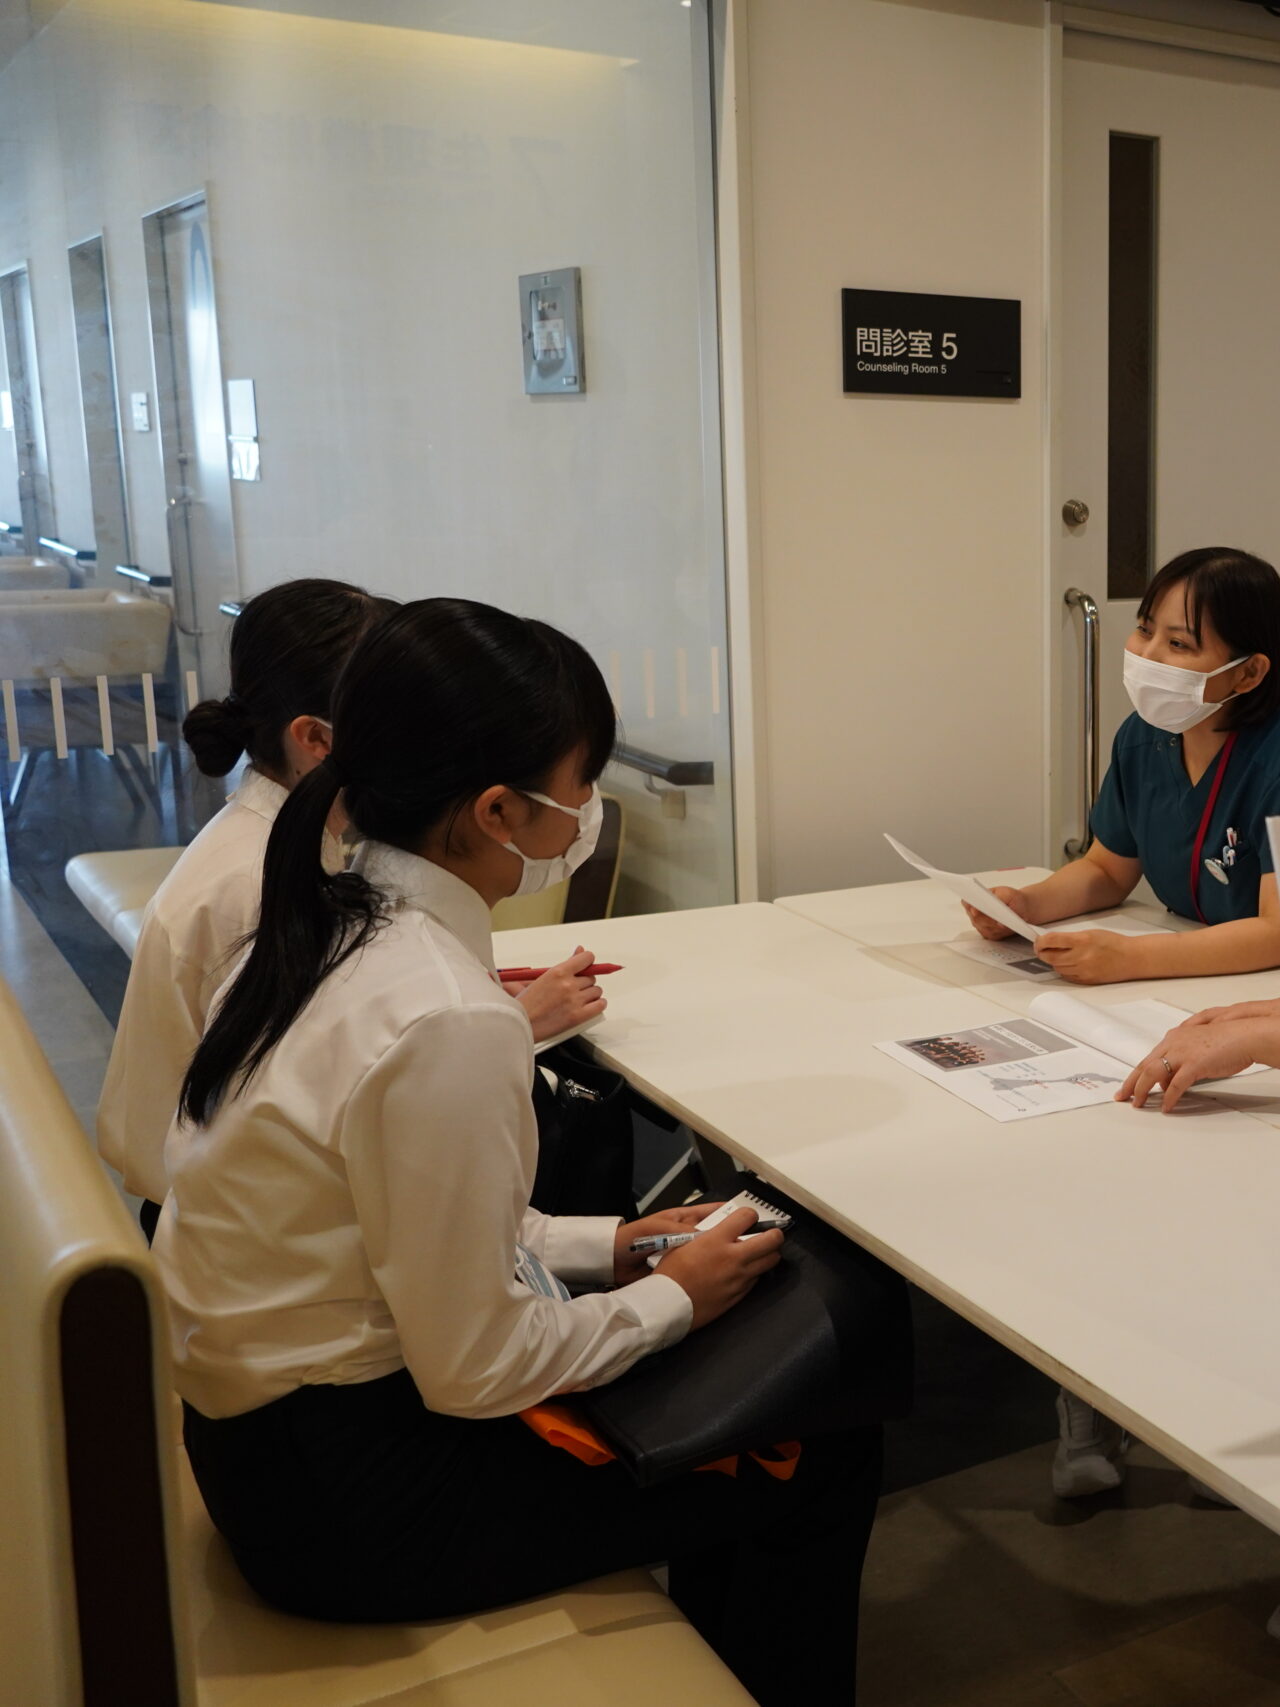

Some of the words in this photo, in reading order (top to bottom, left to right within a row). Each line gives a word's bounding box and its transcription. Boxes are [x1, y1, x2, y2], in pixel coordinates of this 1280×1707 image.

[856, 327, 933, 359] 問診室
[941, 332, 958, 360] 5
[857, 361, 910, 376] Counseling
[911, 362, 939, 375] Room
[940, 363, 948, 375] 5
